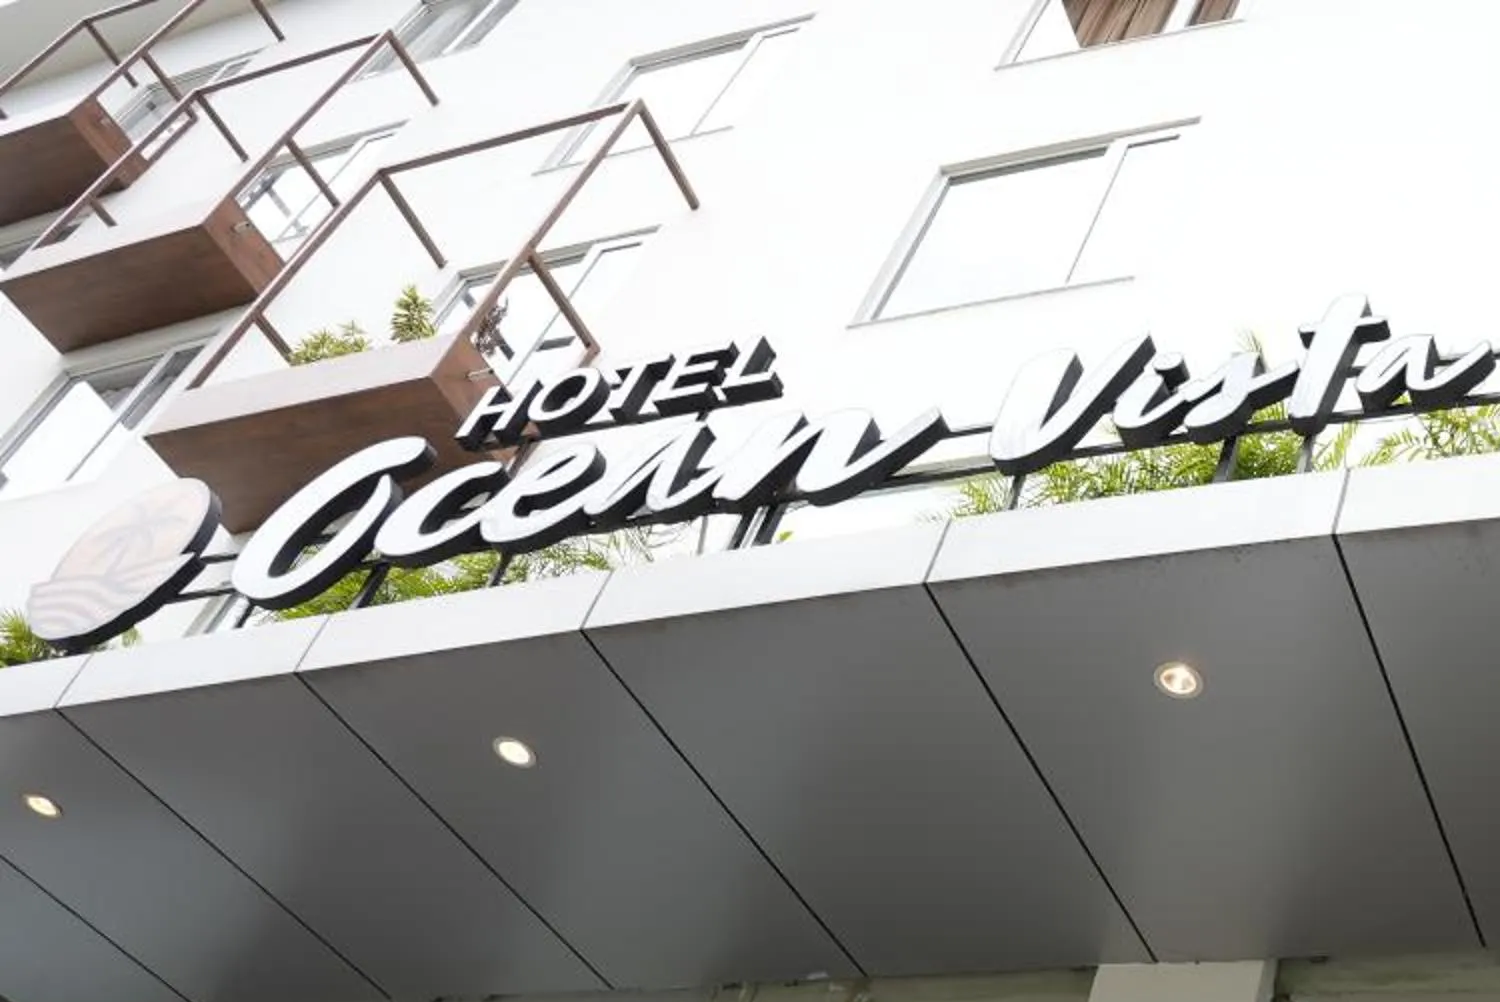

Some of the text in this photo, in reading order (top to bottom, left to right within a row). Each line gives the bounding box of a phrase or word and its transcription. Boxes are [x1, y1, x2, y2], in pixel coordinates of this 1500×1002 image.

[232, 406, 950, 608] Ocean
[988, 294, 1494, 474] Vista
[455, 336, 785, 446] HOTEL
